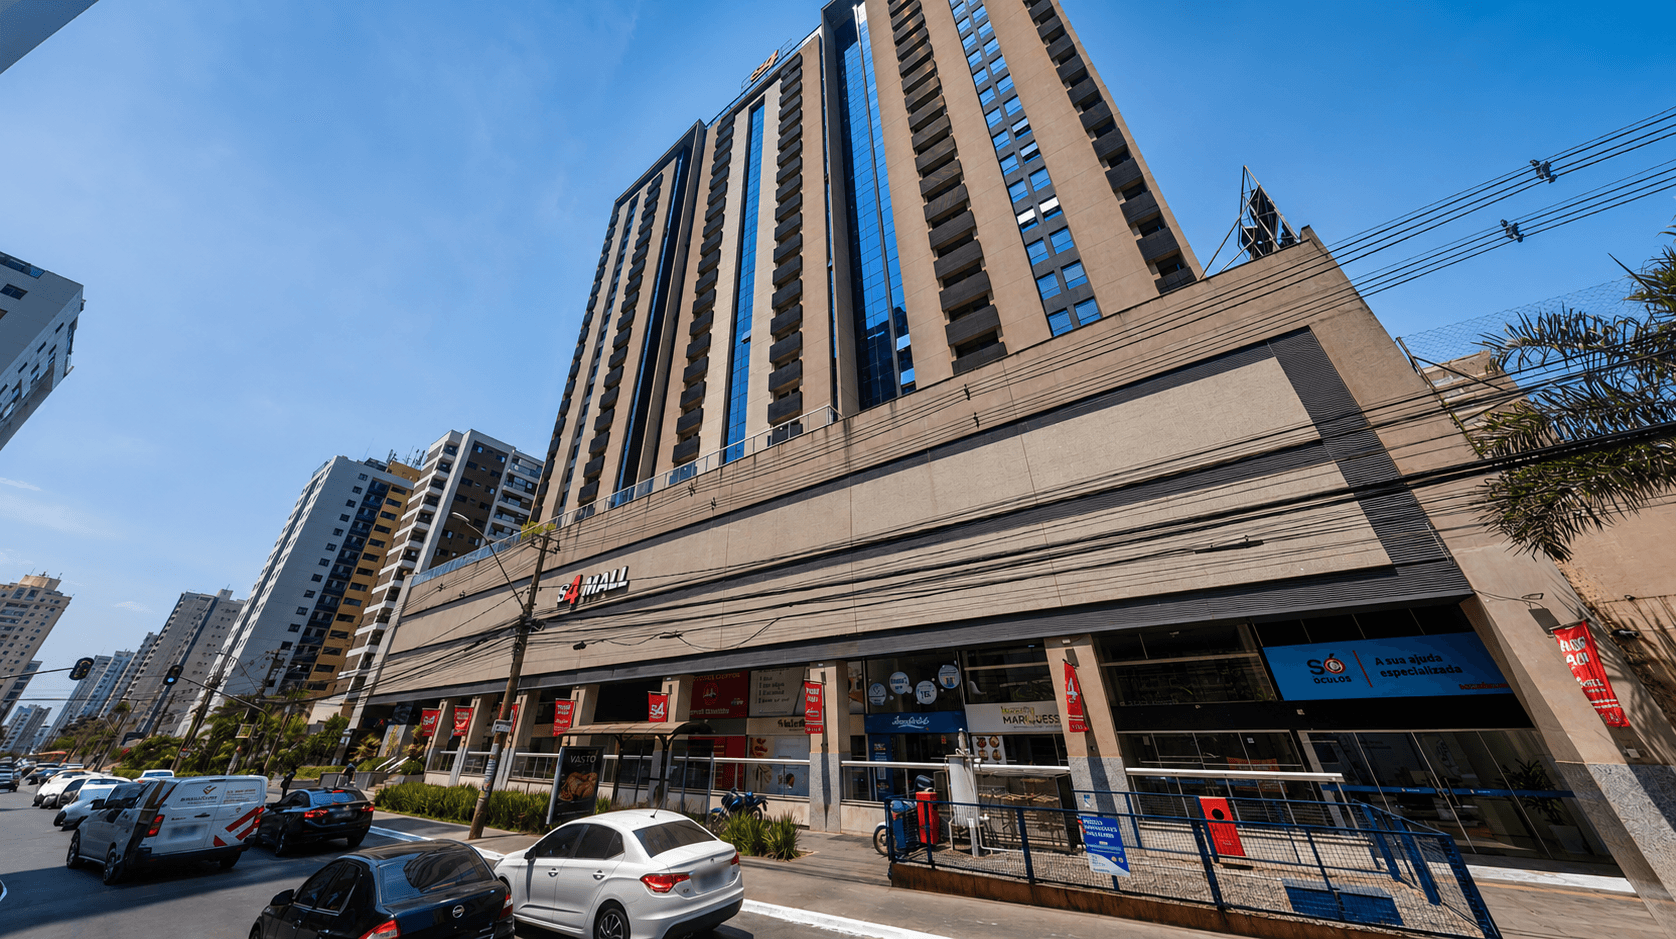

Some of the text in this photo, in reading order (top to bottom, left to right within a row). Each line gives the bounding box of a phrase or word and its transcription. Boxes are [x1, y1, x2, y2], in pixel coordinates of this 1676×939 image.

[557, 566, 629, 604] S4 MALL
[1306, 653, 1346, 675] SÓ
[1375, 653, 1443, 666] A sua ajuda
[1380, 664, 1463, 679] especializada
[570, 755, 597, 764] VASTO
